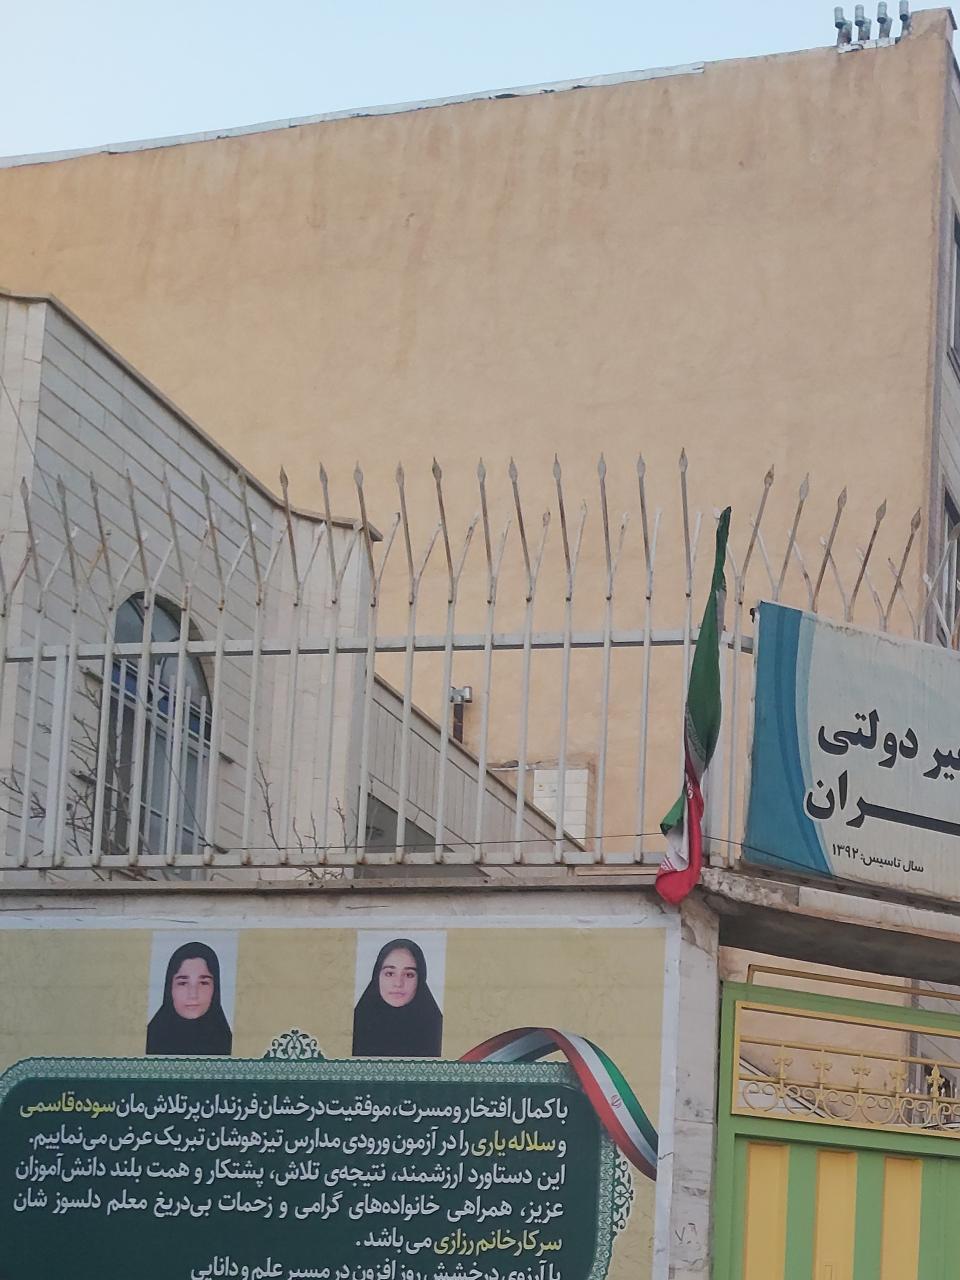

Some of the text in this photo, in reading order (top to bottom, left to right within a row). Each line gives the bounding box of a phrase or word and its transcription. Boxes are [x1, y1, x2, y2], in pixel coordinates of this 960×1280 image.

[818, 709, 918, 768] دولتی
[832, 843, 924, 873] سال تاسیس: ۱۳۹۲
[20, 1092, 75, 1118] قاسمی
[75, 1098, 116, 1118] سوده
[201, 1093, 258, 1120] فرزندان
[259, 1094, 325, 1121] درخشان
[326, 1095, 390, 1122] موفقیت
[392, 1099, 453, 1122] مسرت،
[452, 1106, 462, 1123] و
[461, 1096, 511, 1123] افتخار
[512, 1098, 556, 1123] کمال
[555, 1098, 568, 1124] با
[109, 1126, 152, 1151] عرض
[154, 1125, 205, 1152] تبریک
[206, 1127, 283, 1153] تیزهوشان
[285, 1128, 341, 1154] مدارس
[343, 1133, 390, 1155] ورودی
[393, 1126, 439, 1155] آزمون
[438, 1135, 457, 1156] در
[459, 1129, 469, 1157] را
[472, 1130, 506, 1157] یاری
[508, 1130, 556, 1151] سلاله
[558, 1139, 567, 1157] و
[110, 1157, 143, 1183] بلند
[146, 1161, 189, 1178] همت
[194, 1167, 202, 1184] و
[206, 1158, 264, 1187] پشتکار
[269, 1159, 320, 1186] تلاش،
[391, 1162, 463, 1189] ارزشمند،
[468, 1163, 533, 1189] دستاورد
[537, 1163, 566, 1191] این
[13, 1187, 48, 1212] شان
[52, 1188, 101, 1214] دلسوز
[107, 1188, 148, 1215] معلم
[218, 1192, 274, 1218] زحمات
[279, 1201, 288, 1218] و
[294, 1193, 343, 1219] گرامی
[447, 1195, 512, 1223] همراهی
[520, 1200, 564, 1223] عزیز،
[406, 1237, 432, 1255] می
[433, 1227, 474, 1255] رزازی
[476, 1228, 516, 1256] خانم
[513, 1229, 562, 1257] سرکار
